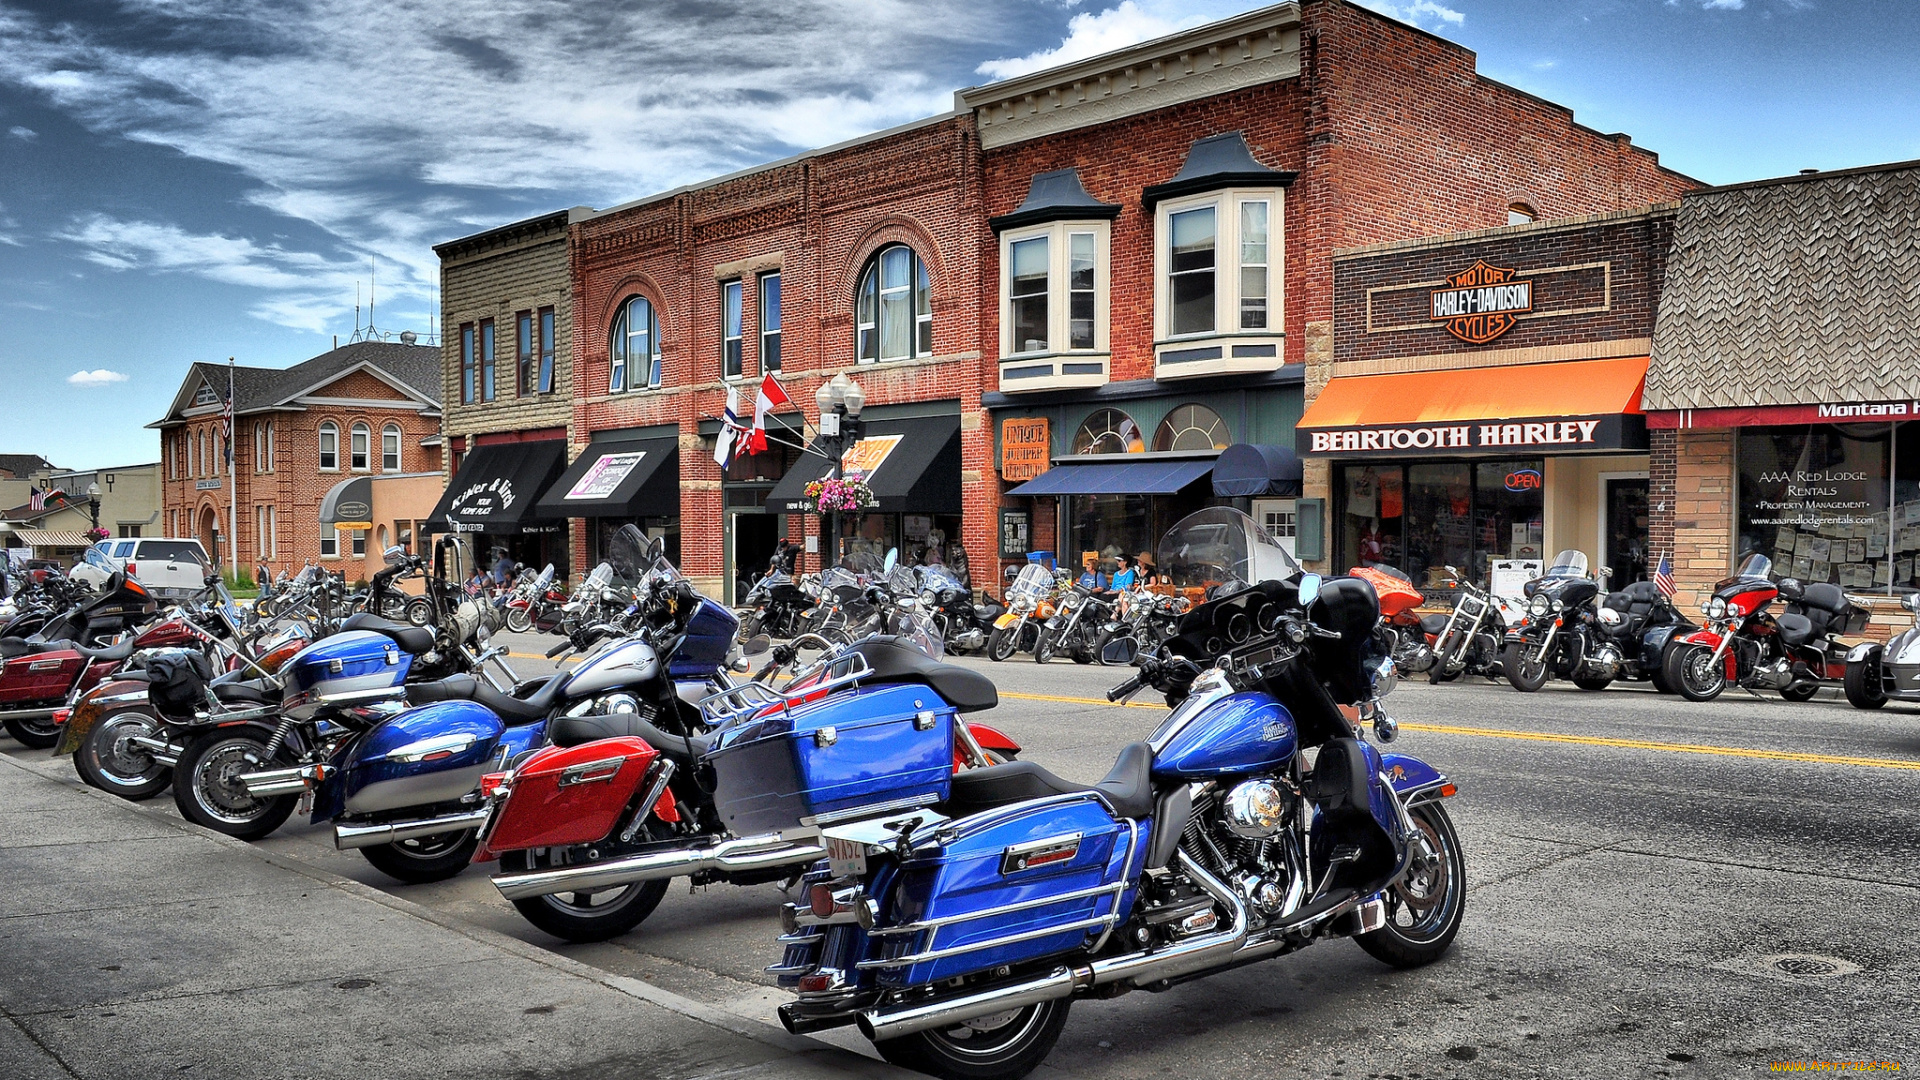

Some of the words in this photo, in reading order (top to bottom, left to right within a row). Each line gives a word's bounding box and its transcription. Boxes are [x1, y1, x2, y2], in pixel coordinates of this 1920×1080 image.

[1456, 265, 1504, 287] MOTOR
[1433, 283, 1529, 317] HARLEY-DAVIDSON
[1455, 314, 1505, 339] CYCLES
[1818, 403, 1907, 417] Montana
[1006, 424, 1044, 444] UNIQUE
[1310, 425, 1471, 452] BEARTOOTH
[1478, 420, 1601, 446] HARLEY
[1006, 446, 1043, 460] JUNIPER
[1505, 473, 1541, 488] OPEN
[1759, 472, 1790, 483] AAA
[451, 482, 488, 510] Kibler
[488, 478, 501, 492] &
[460, 507, 478, 515] HOME
[786, 502, 798, 510] new
[798, 500, 804, 509] &
[1751, 514, 1874, 528] www.aaaredlodgerentals.com
